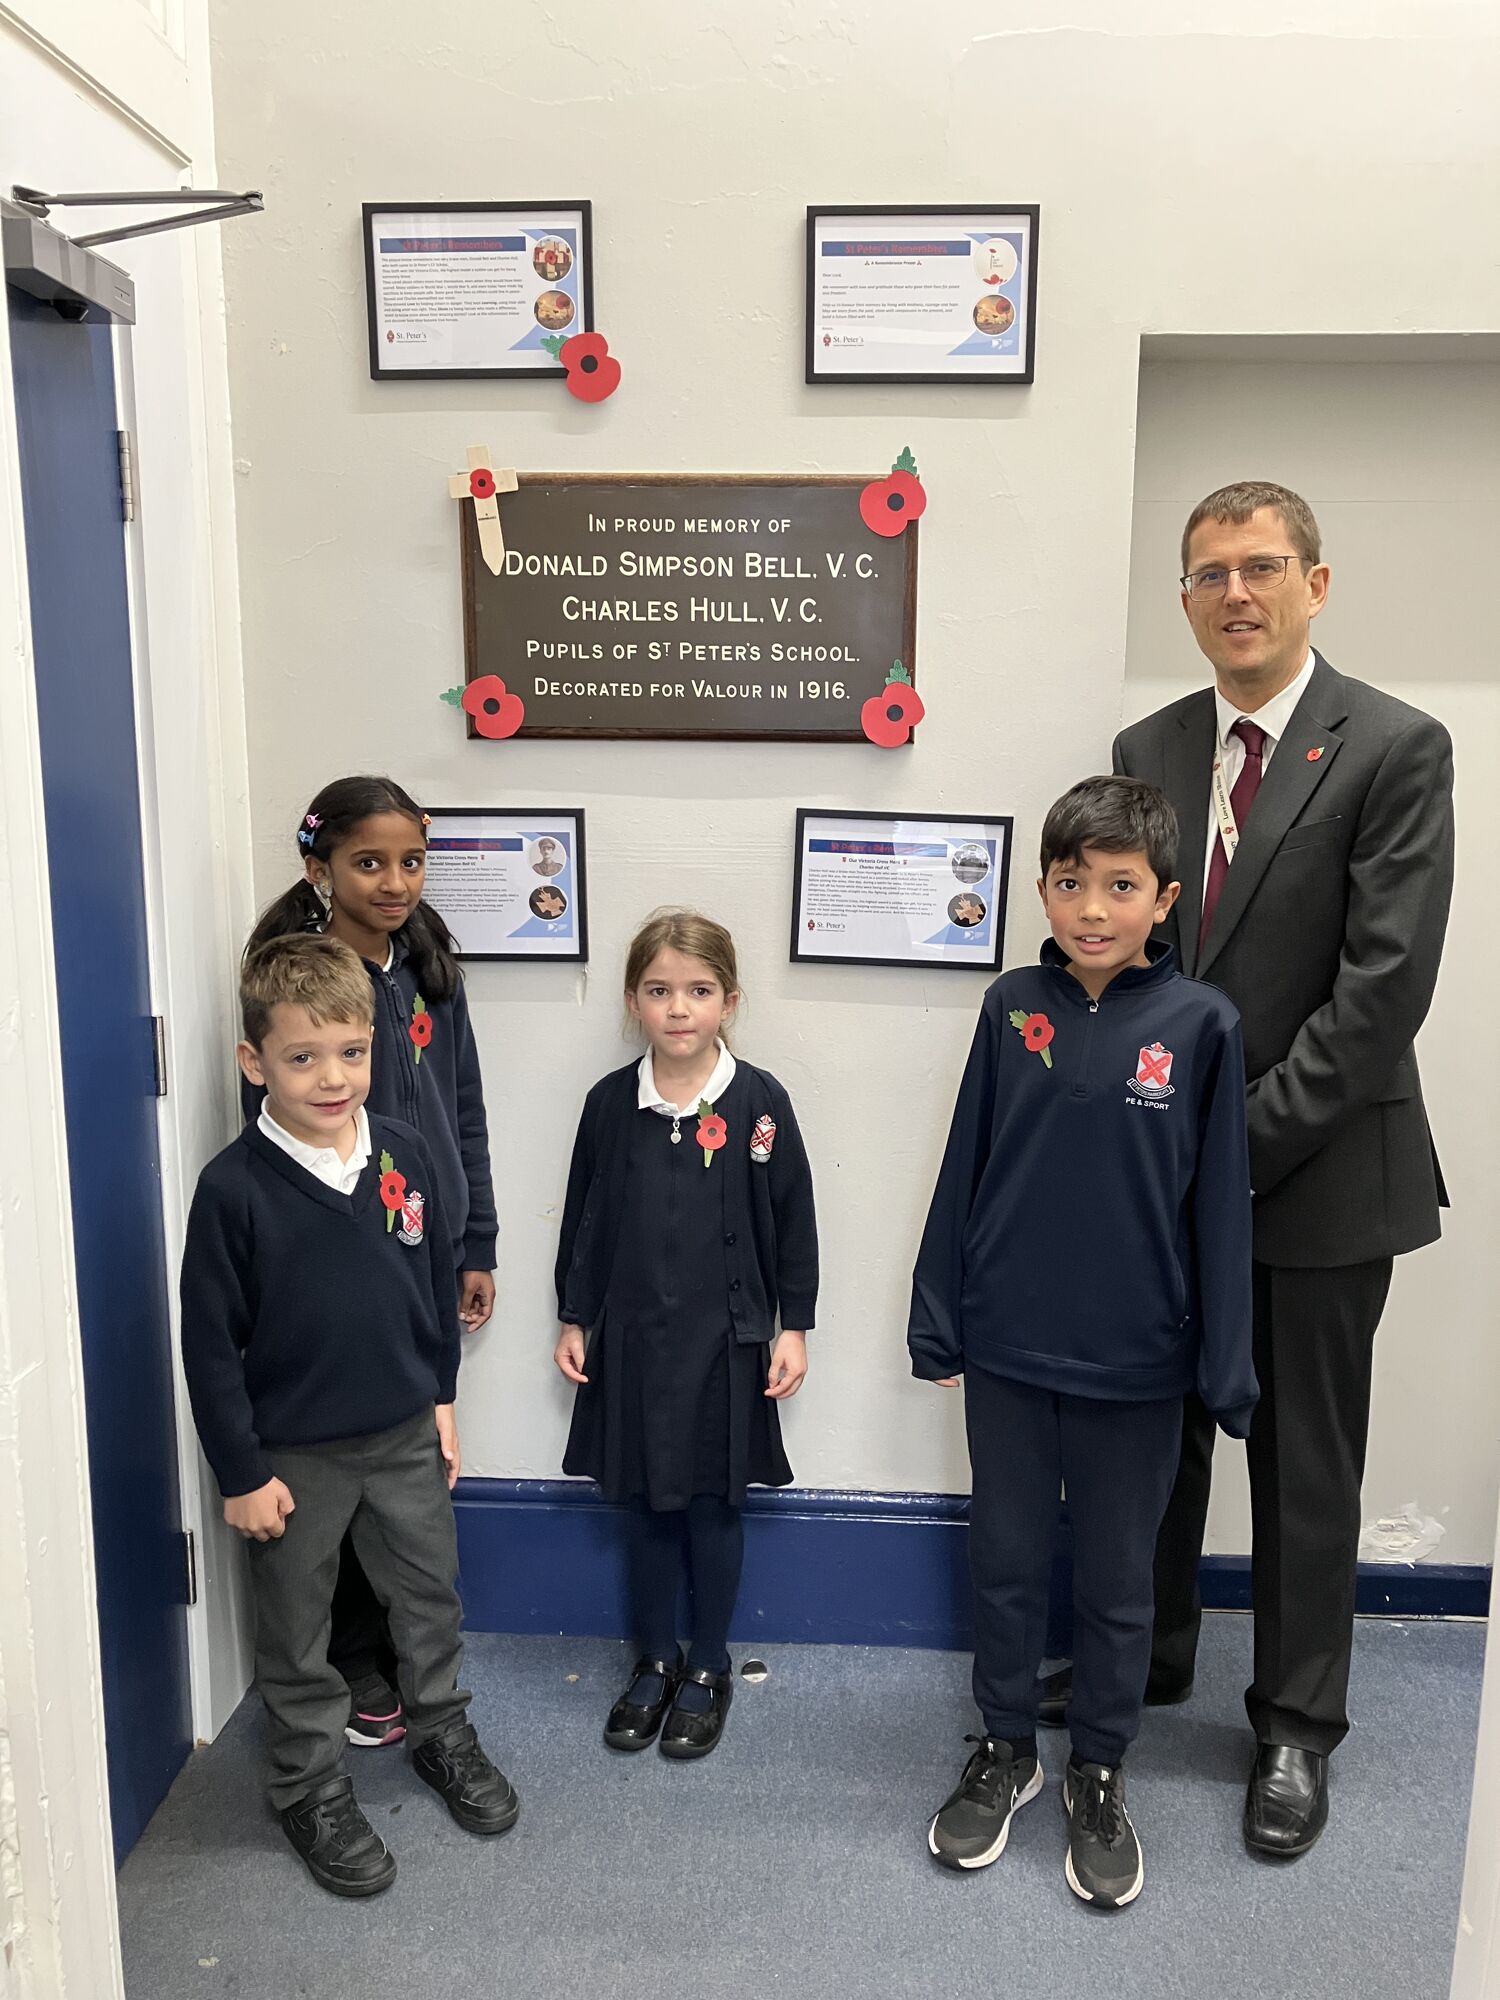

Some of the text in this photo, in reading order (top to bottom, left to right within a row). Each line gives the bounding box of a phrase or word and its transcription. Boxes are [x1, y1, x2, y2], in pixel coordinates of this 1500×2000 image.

[615, 518, 676, 533] PROUD
[685, 518, 761, 534] MEMORY
[768, 518, 792, 534] OF
[504, 550, 608, 577] DONALD
[618, 551, 733, 578] SIMPSON
[562, 595, 679, 622] CHARLES
[526, 640, 604, 660] PUPILS
[612, 644, 638, 660] OF
[679, 641, 761, 662] PETER'S
[770, 643, 861, 663] SCHOOL.
[534, 677, 851, 700] DECORATED FOR VALOUR IN 1916.
[826, 922, 846, 930] Peter's
[1125, 1097, 1136, 1105] PE
[1144, 1100, 1169, 1110] SPORT
